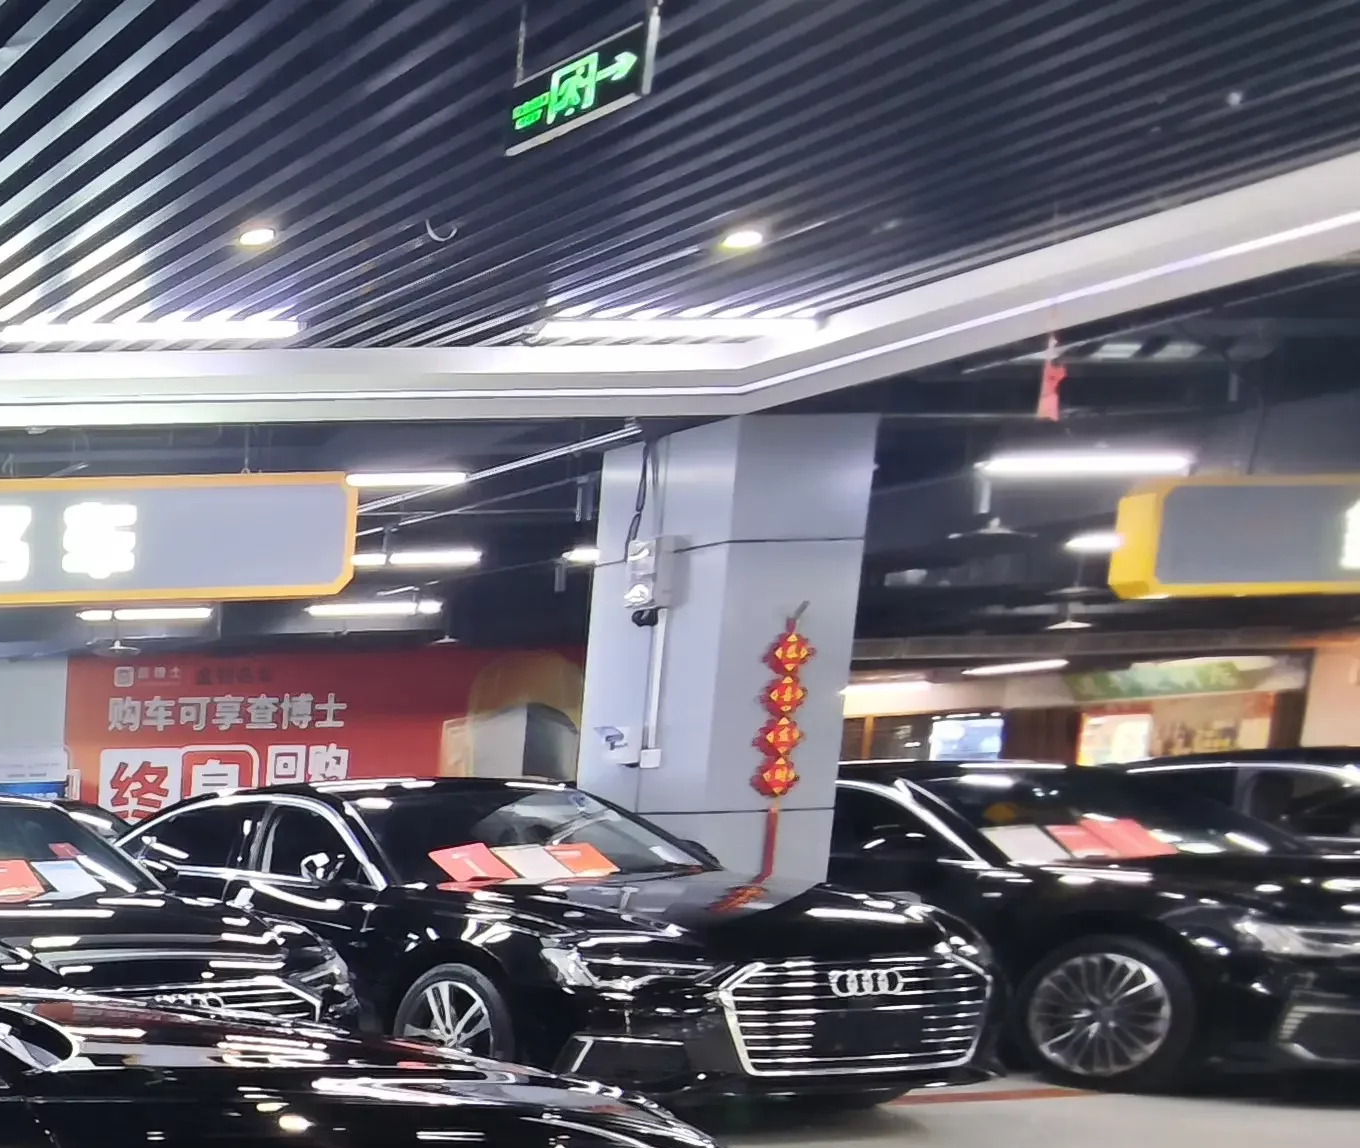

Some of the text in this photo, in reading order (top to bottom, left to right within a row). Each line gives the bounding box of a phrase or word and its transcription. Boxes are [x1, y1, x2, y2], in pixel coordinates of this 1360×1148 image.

[107, 692, 348, 732] 购车可享查博士
[266, 743, 349, 786] 回购
